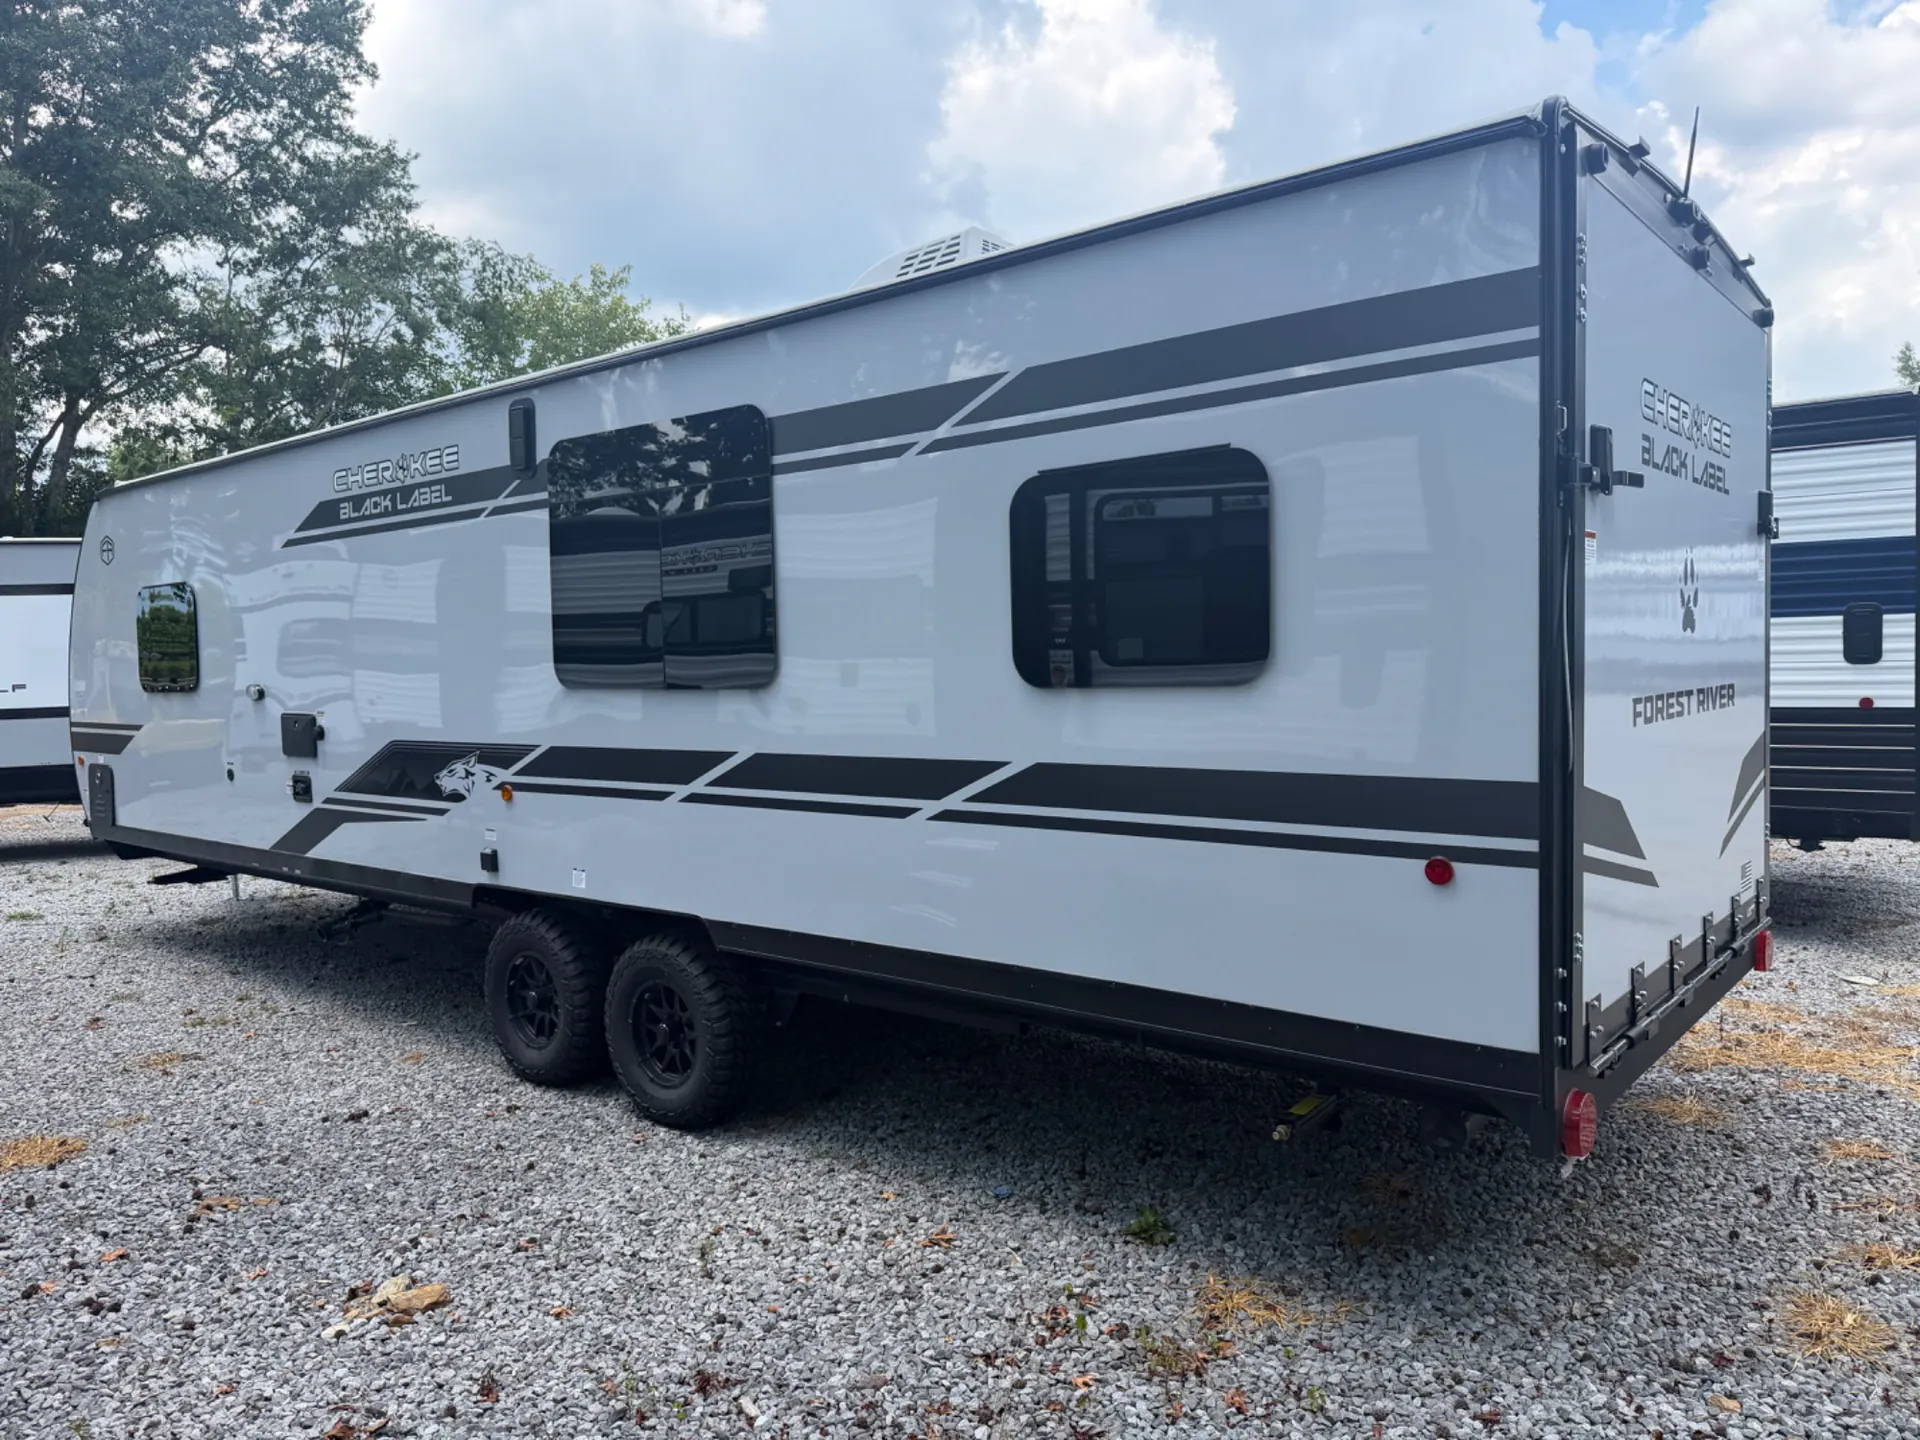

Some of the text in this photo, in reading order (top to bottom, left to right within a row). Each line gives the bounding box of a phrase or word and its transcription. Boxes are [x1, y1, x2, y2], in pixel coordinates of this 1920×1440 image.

[1641, 433, 1730, 495] BLACK LABEL
[340, 484, 452, 519] BLACK LABEL
[1632, 683, 1735, 728] FOREST RIVER
